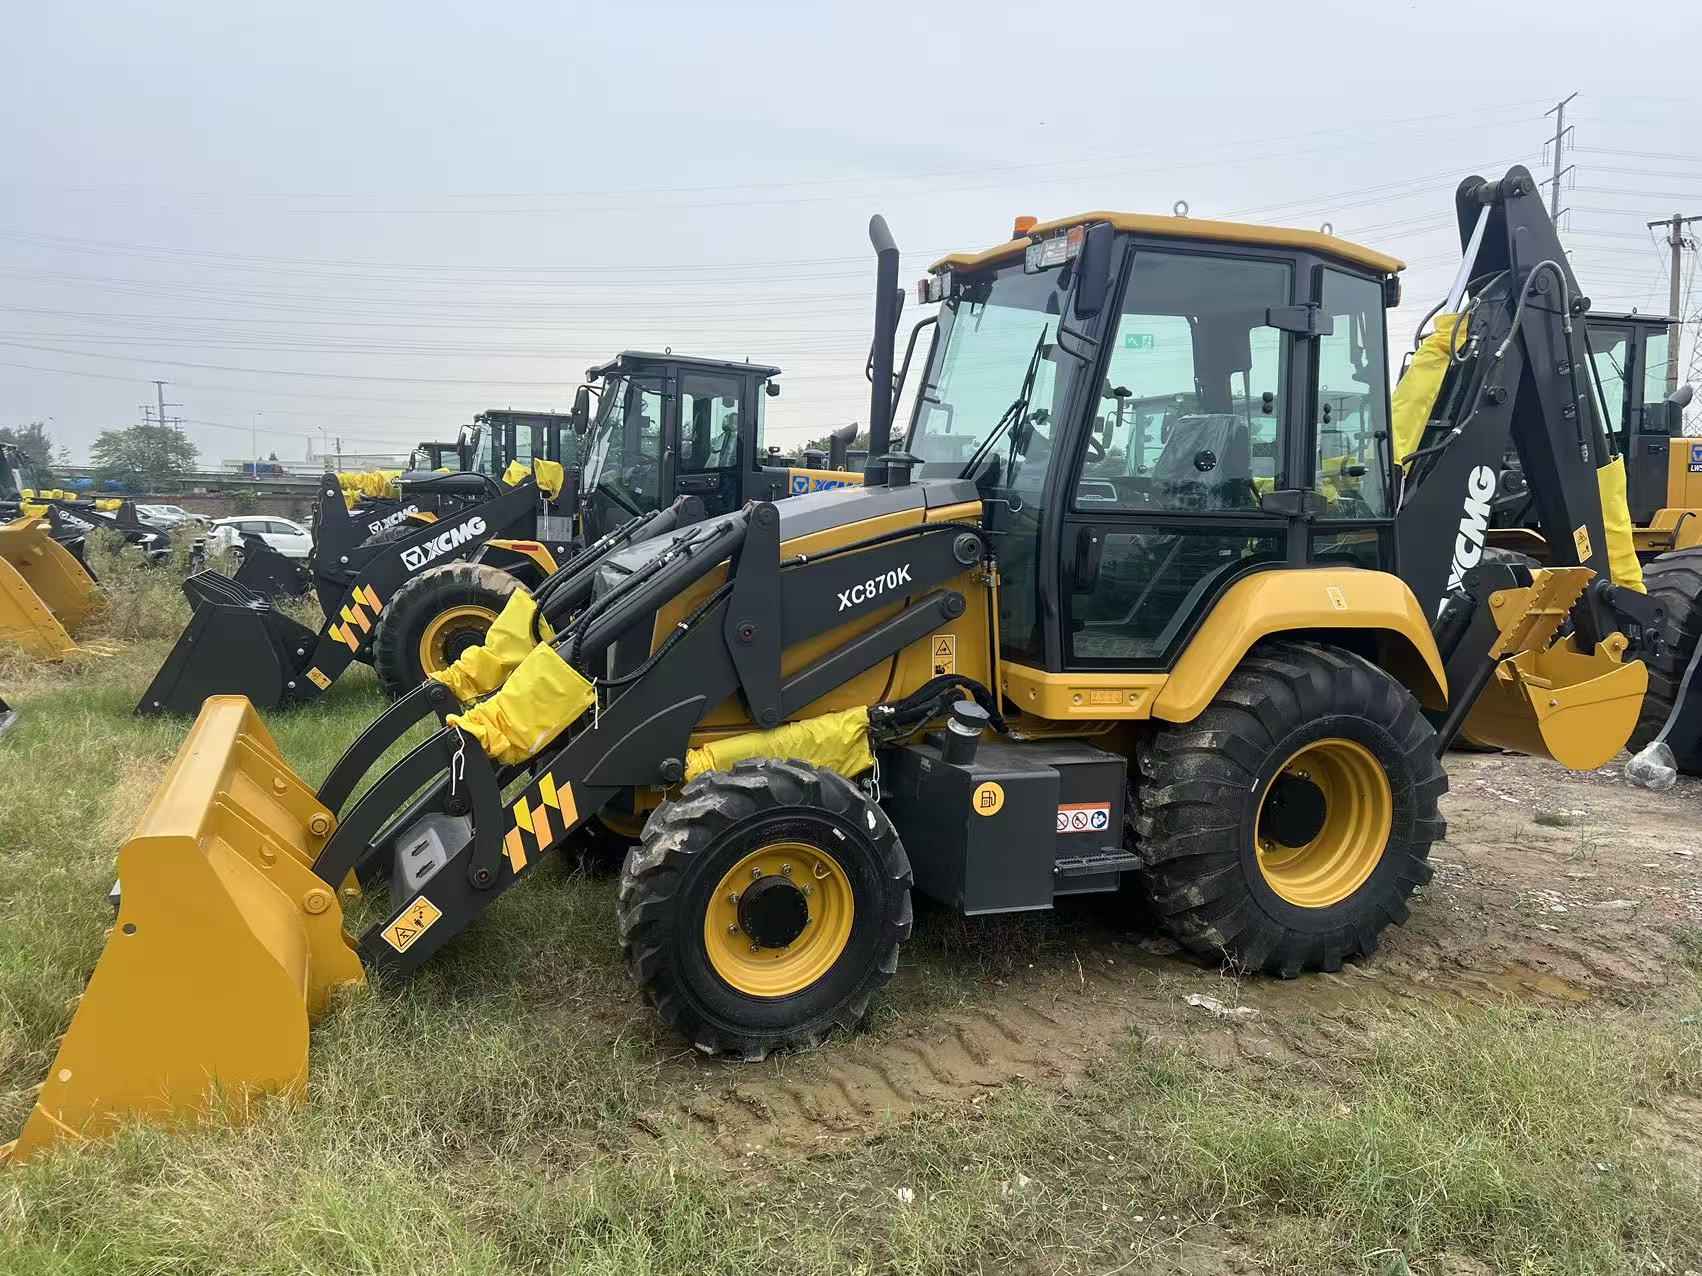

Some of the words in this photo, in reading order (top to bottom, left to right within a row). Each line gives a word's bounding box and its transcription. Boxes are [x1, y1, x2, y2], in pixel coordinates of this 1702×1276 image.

[422, 516, 487, 561] XCMG
[1447, 465, 1496, 592] XCMG
[837, 563, 912, 611] XC870K
